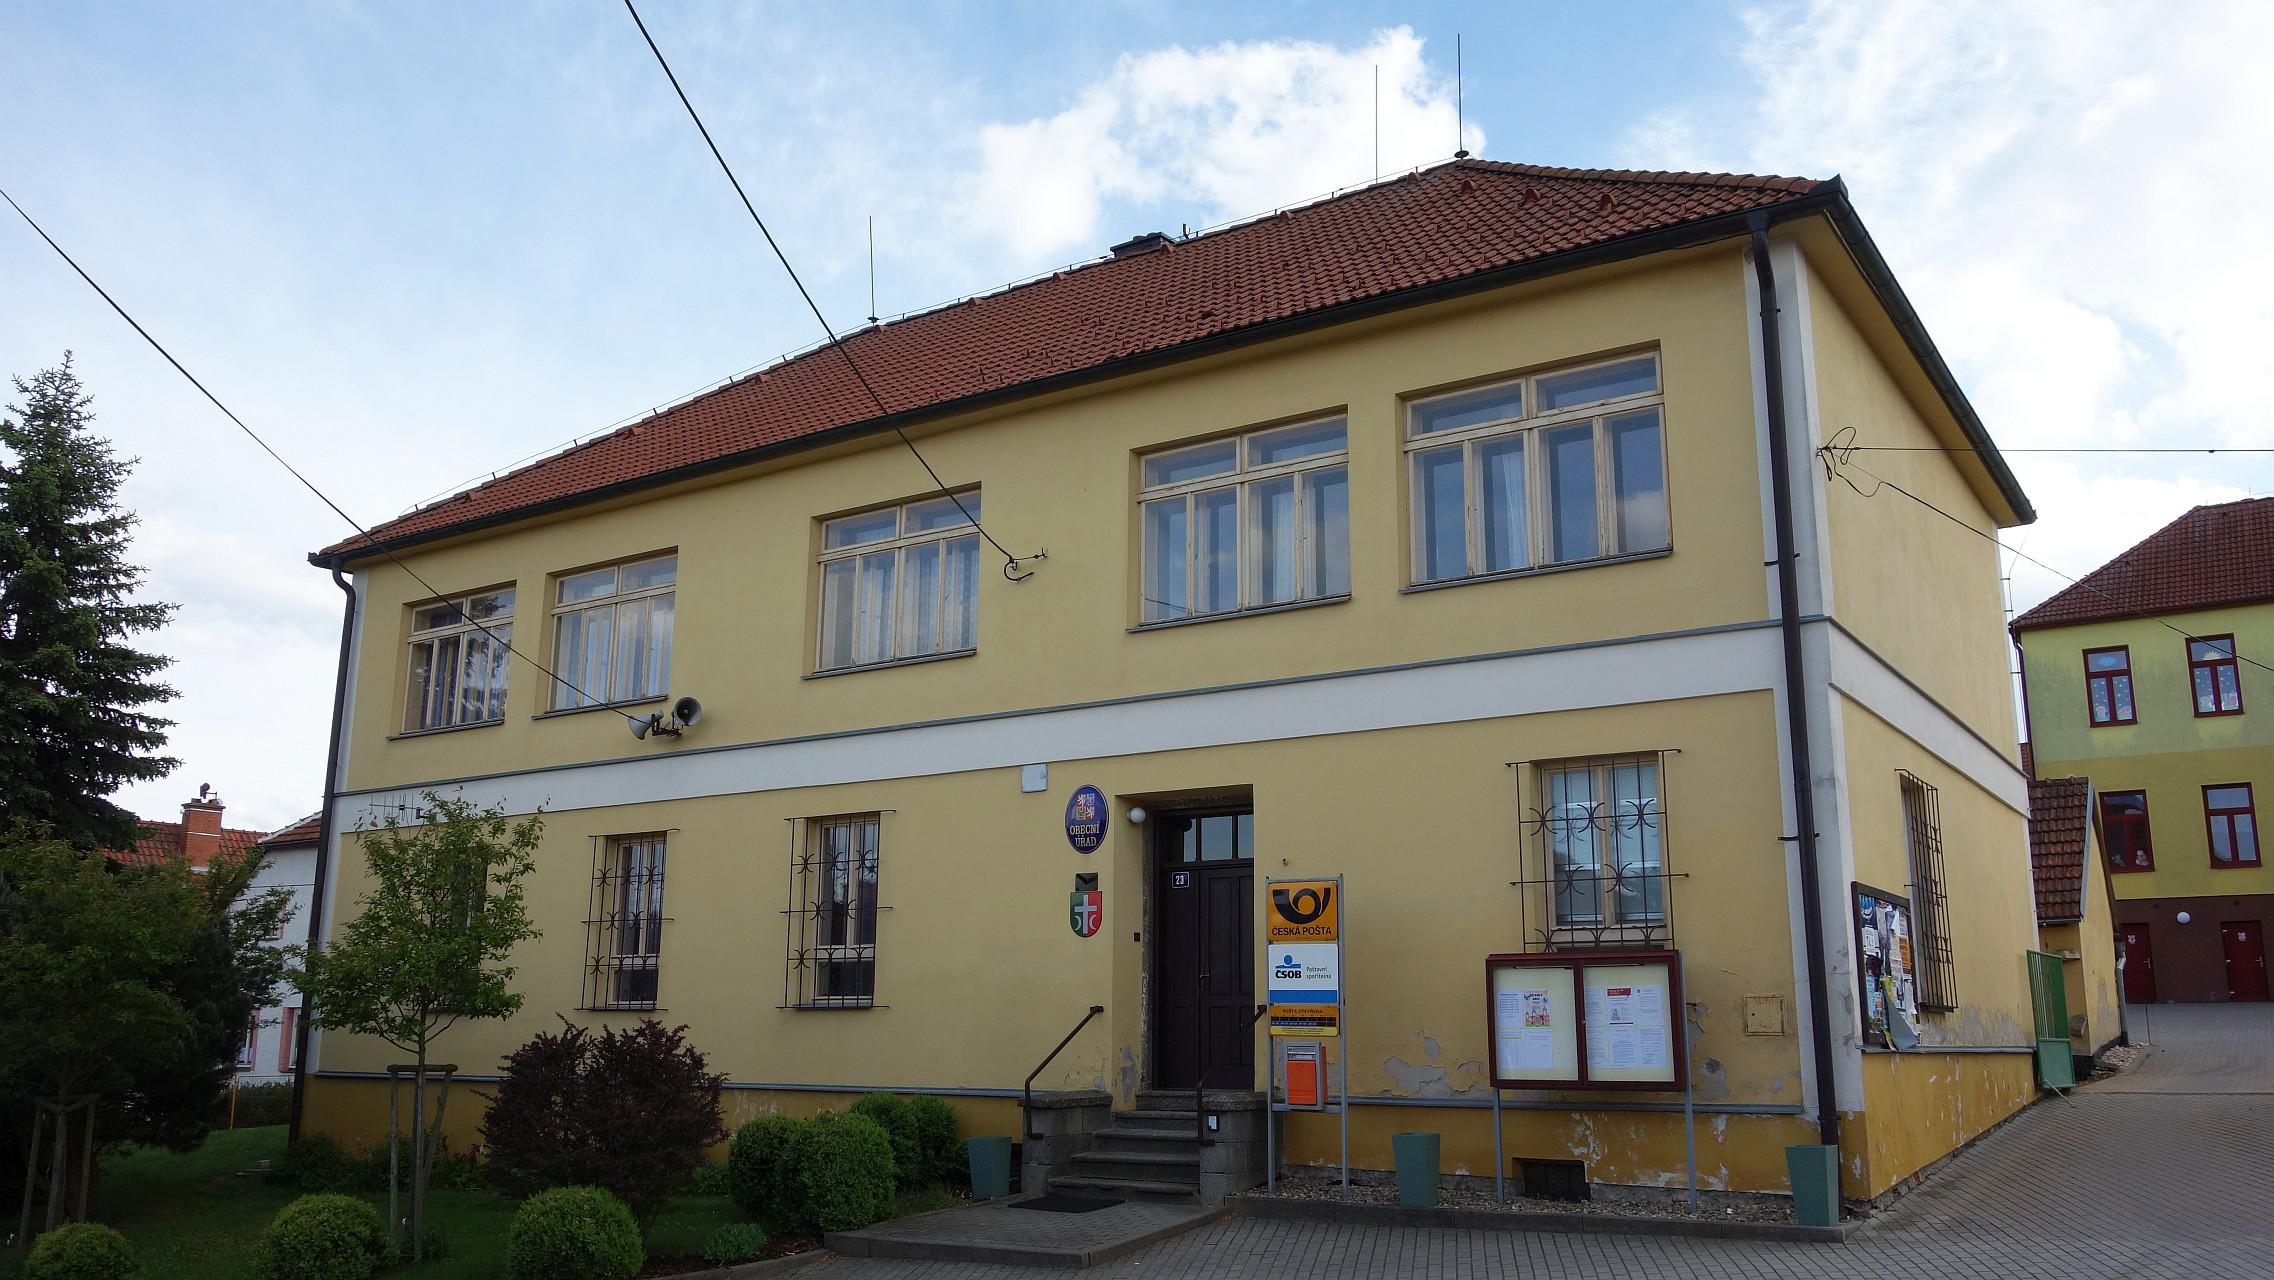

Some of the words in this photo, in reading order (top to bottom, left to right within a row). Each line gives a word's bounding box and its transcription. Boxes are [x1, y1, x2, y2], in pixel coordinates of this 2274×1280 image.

[1070, 821, 1100, 835] OBECNÍ
[1075, 835, 1097, 847] ÚŘAD
[1175, 875, 1184, 885] 23
[1272, 926, 1300, 936] ČESKÁ
[1302, 926, 1331, 936] POŠTA
[1275, 969, 1302, 979] ČSOB
